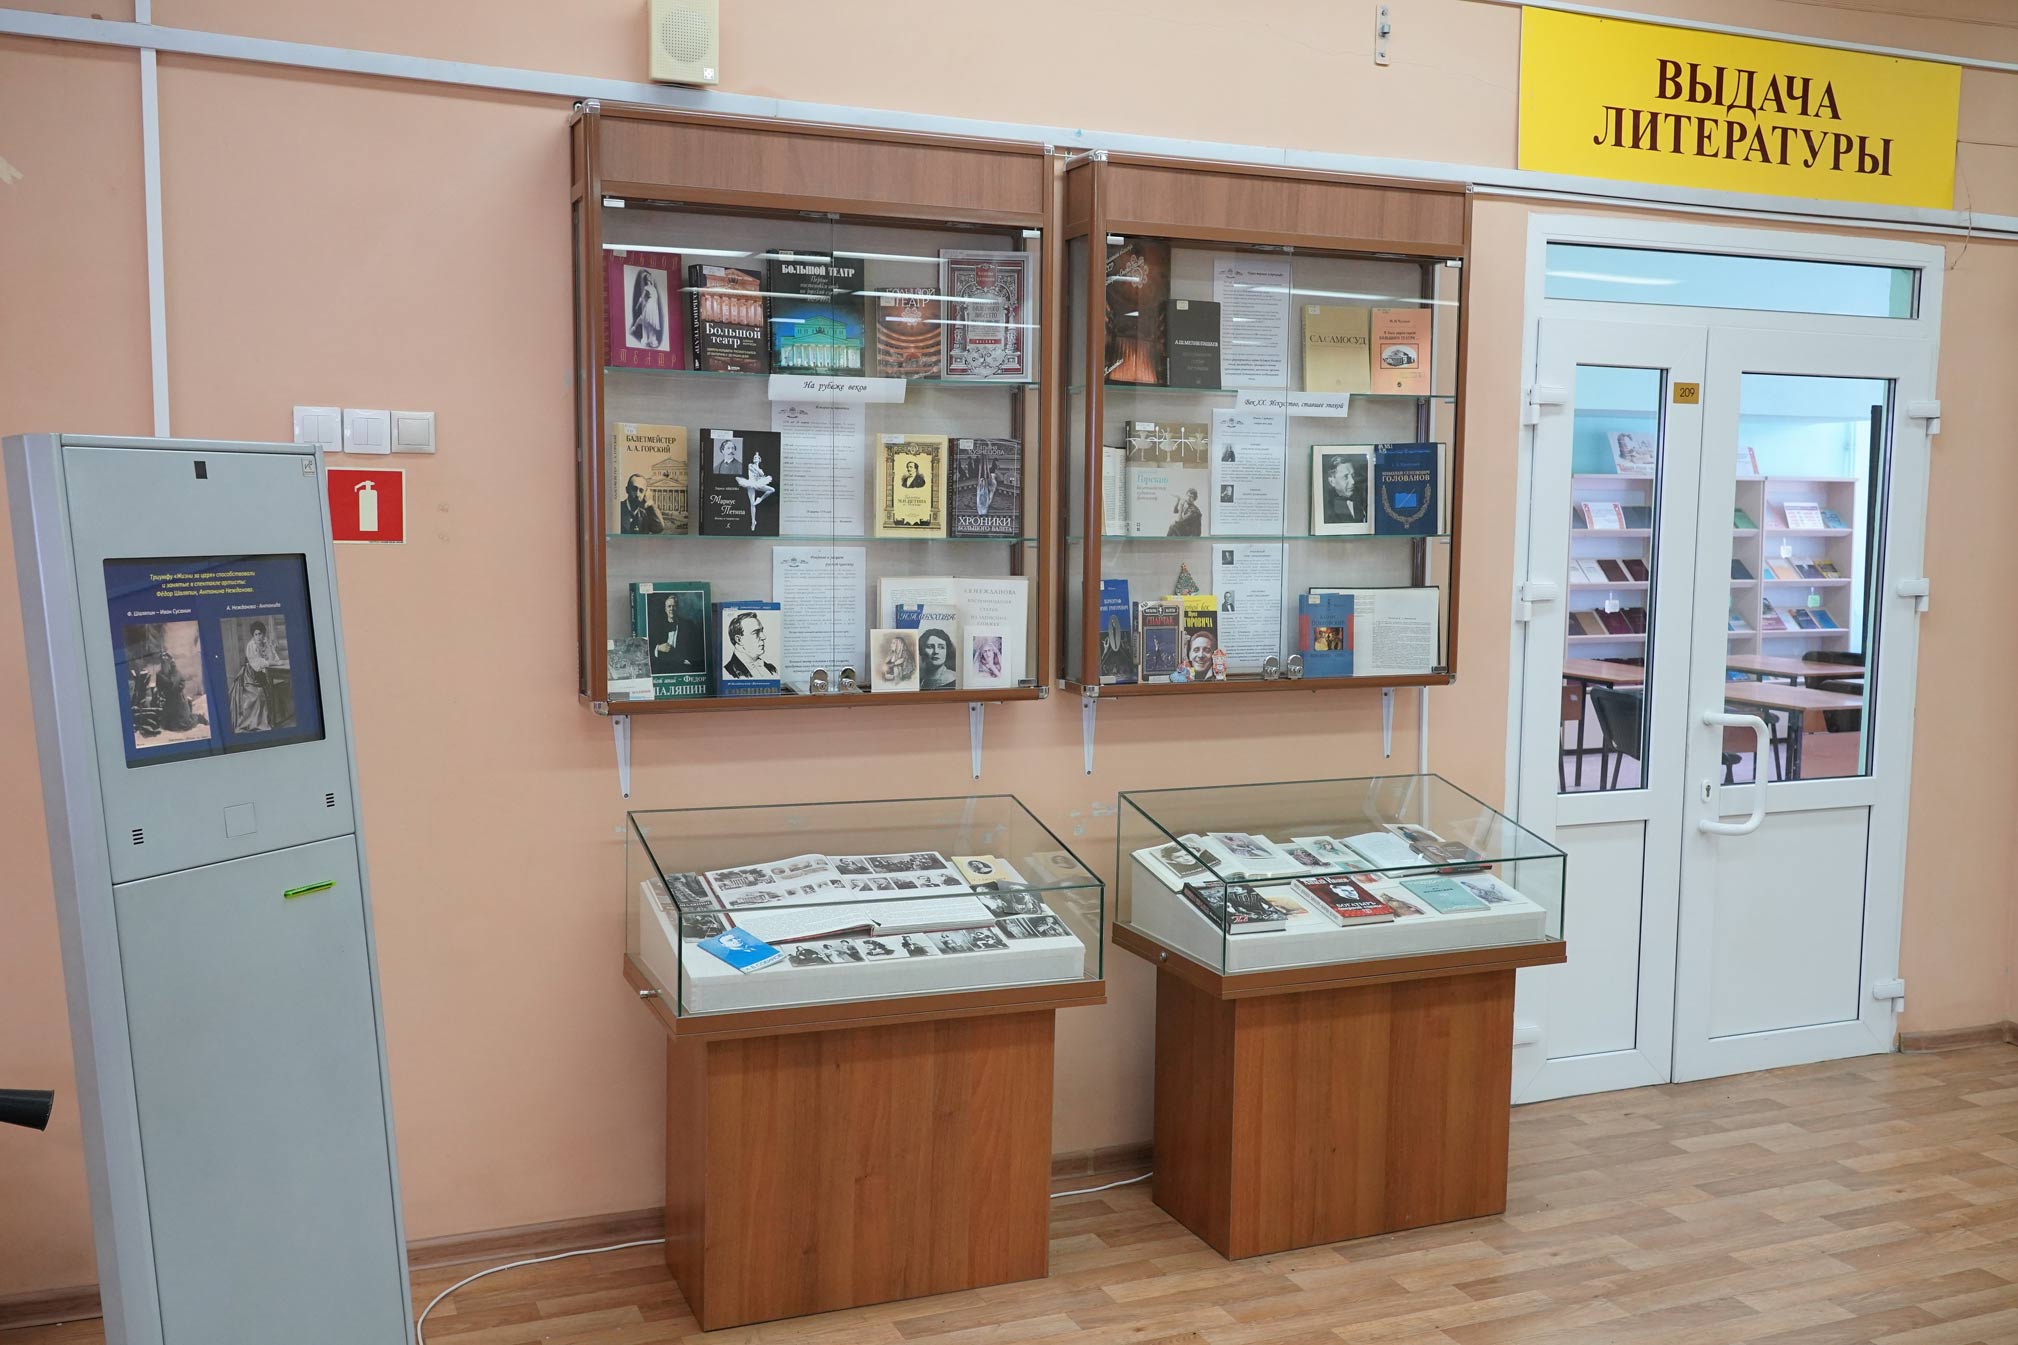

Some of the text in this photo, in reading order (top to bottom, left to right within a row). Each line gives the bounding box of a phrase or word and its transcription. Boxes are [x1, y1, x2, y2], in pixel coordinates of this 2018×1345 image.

[1655, 58, 1842, 121] ВЫДАЧА
[1593, 105, 1895, 176] ЛИТЕРАТУРЫ
[782, 264, 855, 278] БОЛЬШОЙ ТЕАТР
[705, 322, 761, 339] Большой
[710, 336, 741, 348] театр
[803, 381, 815, 389] На
[818, 381, 845, 392] рубеже
[1680, 388, 1696, 398] 209
[626, 434, 676, 444] БАЛЕТМЕЙСТЕР
[710, 495, 735, 505] Мариус
[721, 506, 745, 515] Петипа
[958, 516, 1011, 526] ХРОНИКИ
[1147, 616, 1174, 625] СПАРТАК
[1184, 617, 1213, 627] ГОРОВИЧА
